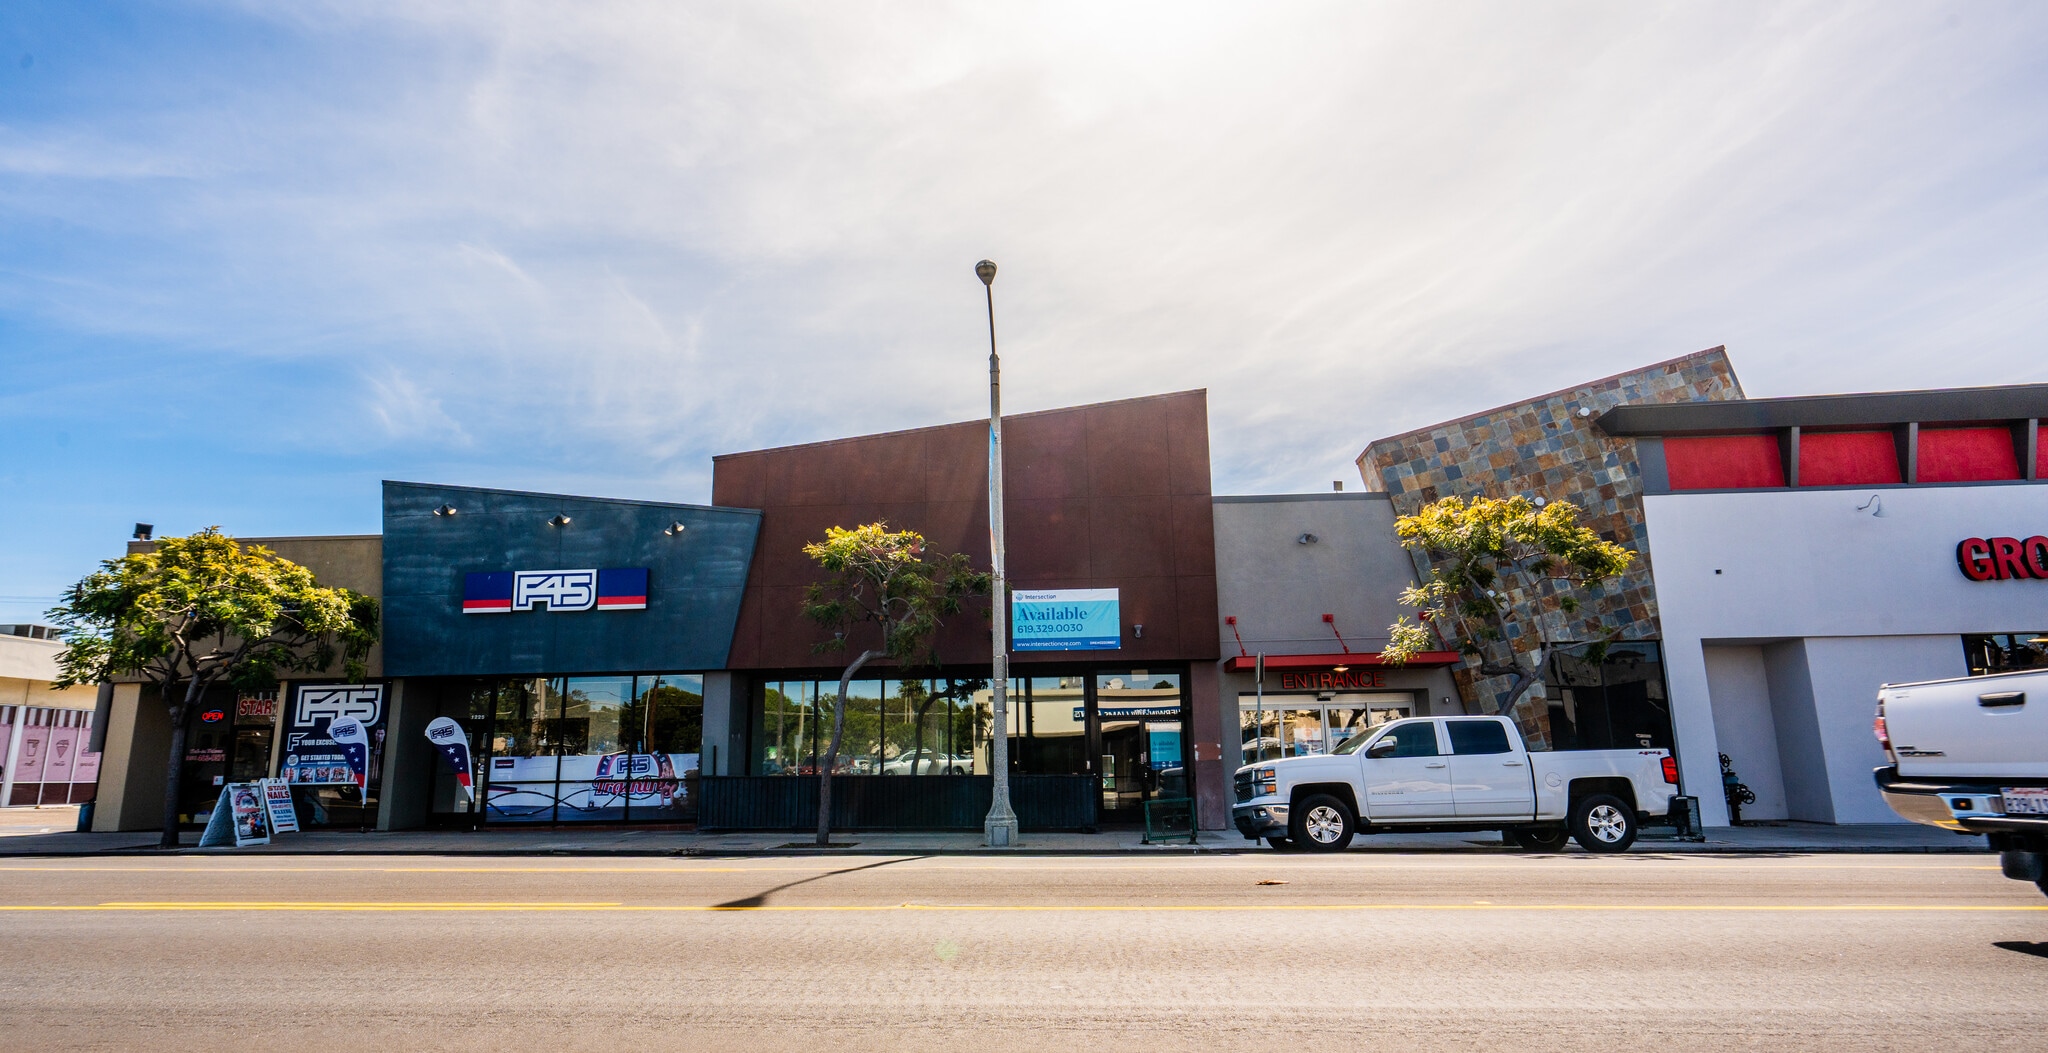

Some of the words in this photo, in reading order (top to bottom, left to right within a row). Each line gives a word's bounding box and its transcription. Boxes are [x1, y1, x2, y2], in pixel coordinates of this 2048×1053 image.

[513, 569, 597, 611] F45
[1017, 606, 1088, 620] Available
[1017, 623, 1083, 634] 619.329.0030
[1283, 671, 1387, 689] ENTRANCE
[239, 699, 274, 716] STAR
[294, 684, 384, 727] F45
[202, 711, 225, 721] OPEN
[332, 724, 357, 738] F45
[430, 725, 455, 739] F45
[267, 791, 290, 800] NAILS
